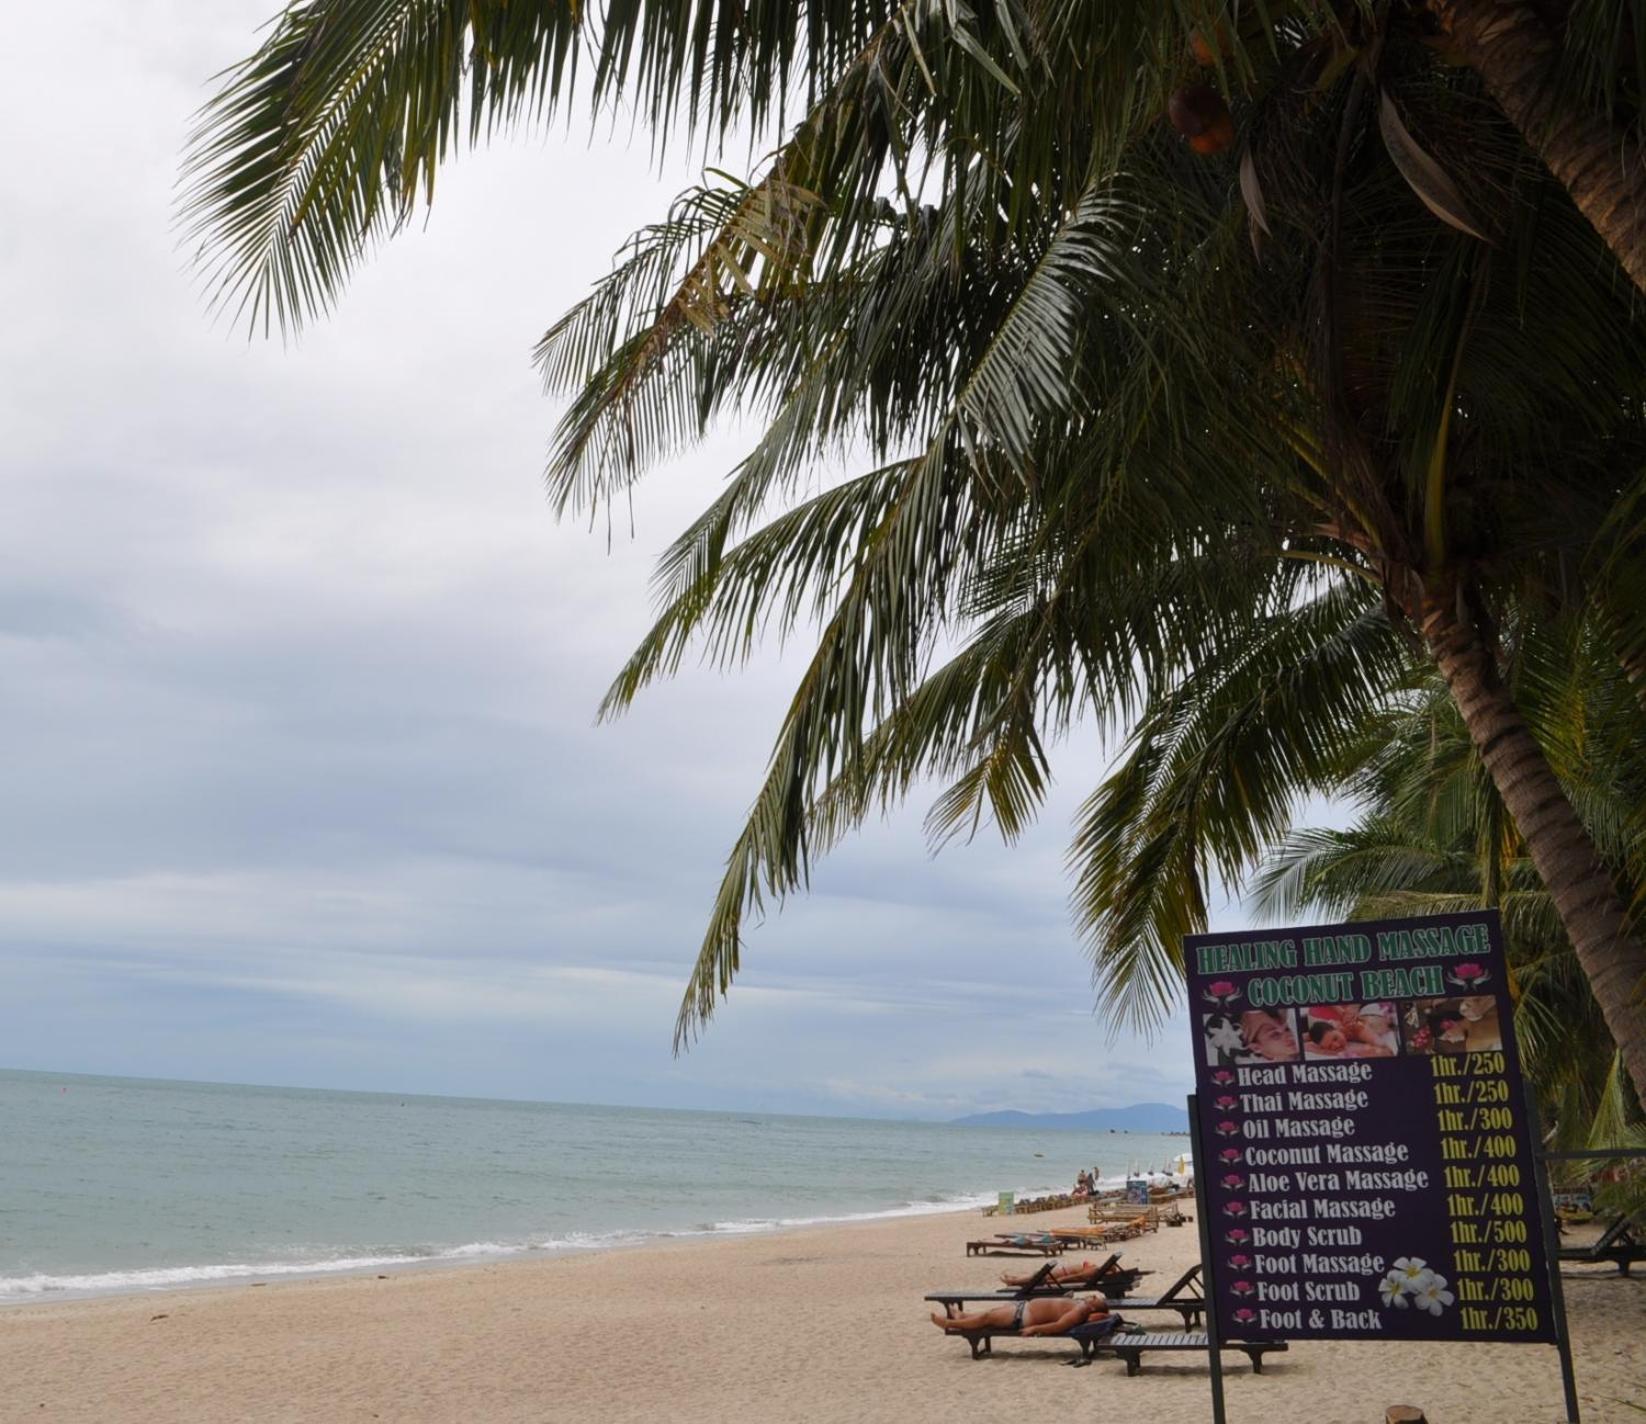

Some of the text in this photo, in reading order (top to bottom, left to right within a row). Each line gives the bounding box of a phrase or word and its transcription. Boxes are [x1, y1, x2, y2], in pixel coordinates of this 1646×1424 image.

[1197, 924, 1491, 974] HEALING HAND MASSAGE
[1248, 966, 1444, 1007] COCONUT BEACH
[1238, 1062, 1372, 1087] Head Massage
[1431, 1053, 1505, 1077] 1hr./250
[1240, 1089, 1369, 1112] Thai Massage
[1434, 1080, 1509, 1104] 1hr./250
[1243, 1117, 1355, 1139] Oil Massage
[1437, 1108, 1512, 1131] 1hr./300
[1245, 1143, 1408, 1166] Coconut Massage
[1440, 1136, 1516, 1160] 1hr./400
[1249, 1169, 1428, 1192] Aloe Vera Massage
[1444, 1165, 1520, 1188] 1hr./400
[1250, 1198, 1395, 1220] Facial Massage
[1448, 1193, 1523, 1216] 1hr./400
[1253, 1226, 1361, 1248] Body Scrub
[1450, 1221, 1527, 1244] 1hr./500
[1255, 1253, 1385, 1274] Foot Massage
[1453, 1249, 1530, 1272] 1hr./300
[1257, 1280, 1360, 1301] Foot Scrub
[1457, 1278, 1534, 1301] 1hr./300
[1260, 1309, 1382, 1330] Foot & Back
[1461, 1307, 1537, 1331] 1hr./350
